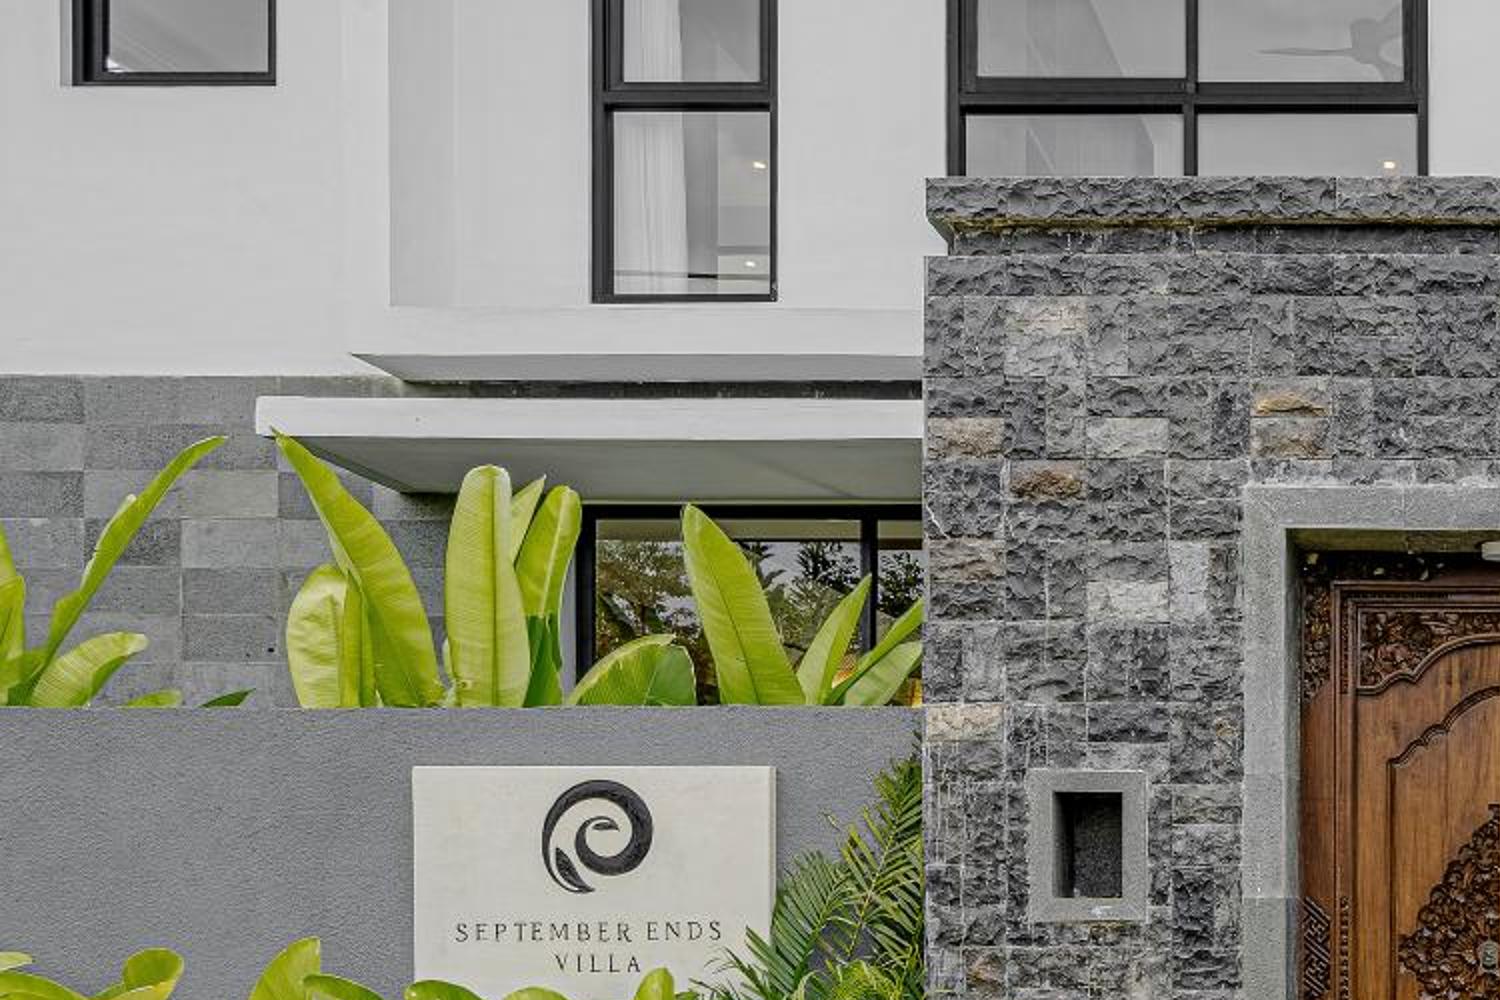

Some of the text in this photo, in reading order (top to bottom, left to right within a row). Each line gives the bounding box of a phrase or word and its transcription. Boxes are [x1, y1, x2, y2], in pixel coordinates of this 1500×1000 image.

[455, 920, 722, 943] SEPTEMBER ENDS
[554, 952, 642, 974] VILLA
